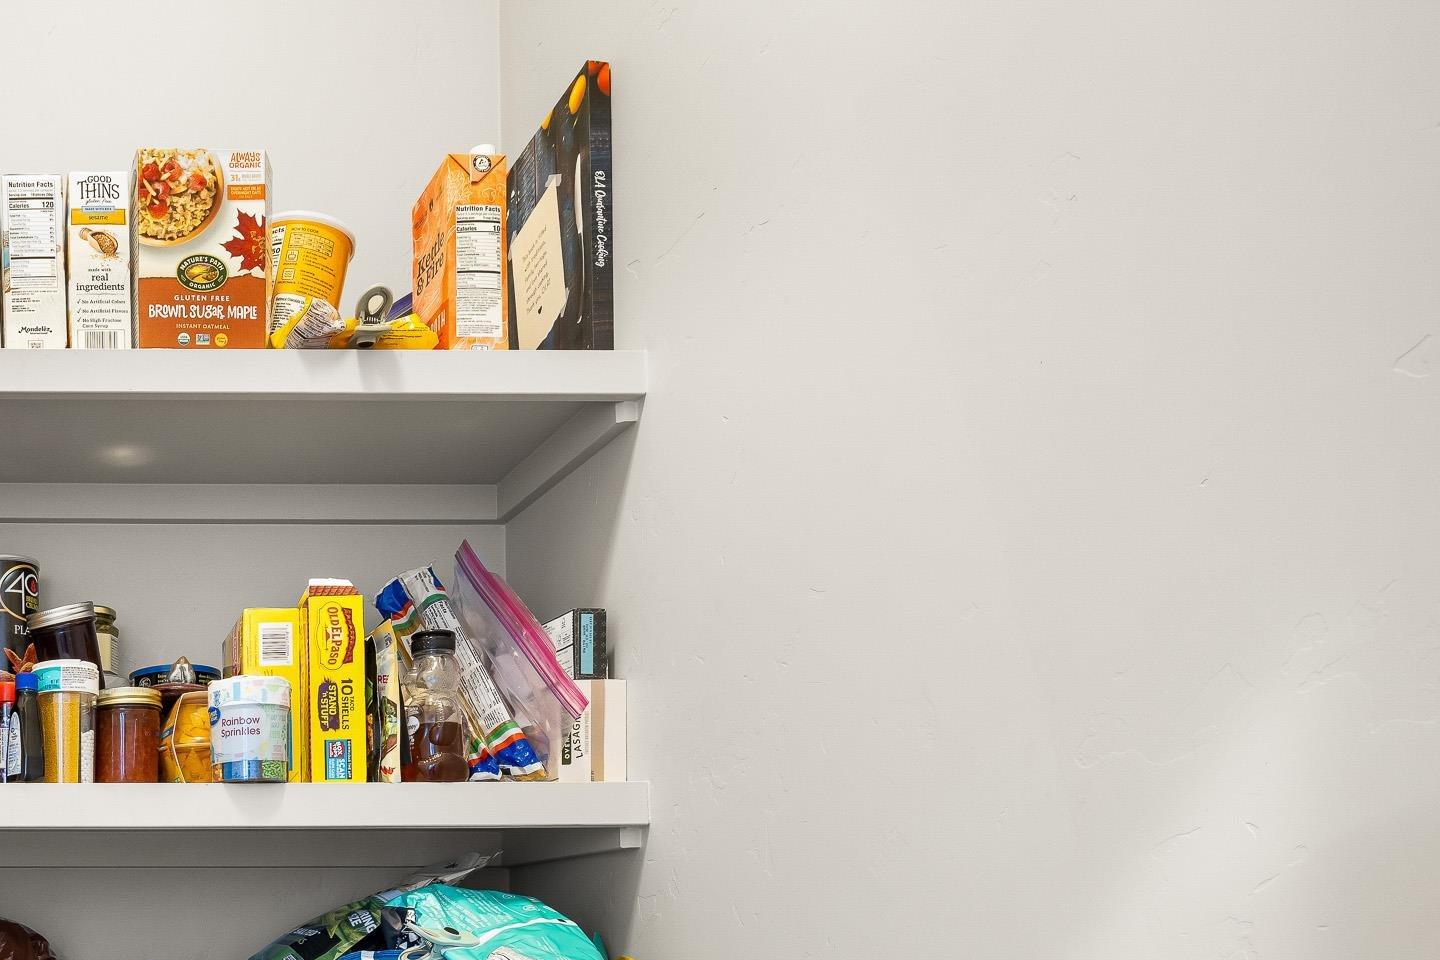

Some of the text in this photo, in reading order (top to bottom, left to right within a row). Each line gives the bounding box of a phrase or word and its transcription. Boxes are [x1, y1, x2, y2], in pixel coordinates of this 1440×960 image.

[230, 151, 261, 163] ALWAYS
[229, 161, 261, 169] ORGANIC
[87, 175, 112, 183] GOOD
[77, 180, 120, 200] THINS
[417, 231, 445, 278] Kettle
[594, 234, 609, 268] Cooking
[180, 256, 224, 272] NATURE'S PATH
[91, 273, 109, 282] real
[417, 252, 444, 296] & Fire
[76, 282, 125, 292] ingredients
[189, 282, 216, 290] ORGANIC
[227, 305, 258, 320] MAPLE
[327, 606, 339, 627] OLD
[14, 624, 31, 635] PLA
[332, 626, 343, 640] EL
[329, 684, 337, 716] STAND
[341, 678, 353, 730] 10 SHELLS
[320, 698, 329, 730] STUFF
[221, 717, 260, 728] Rainbow
[221, 727, 261, 741] Sprinkles
[572, 714, 584, 759] LASAGN
